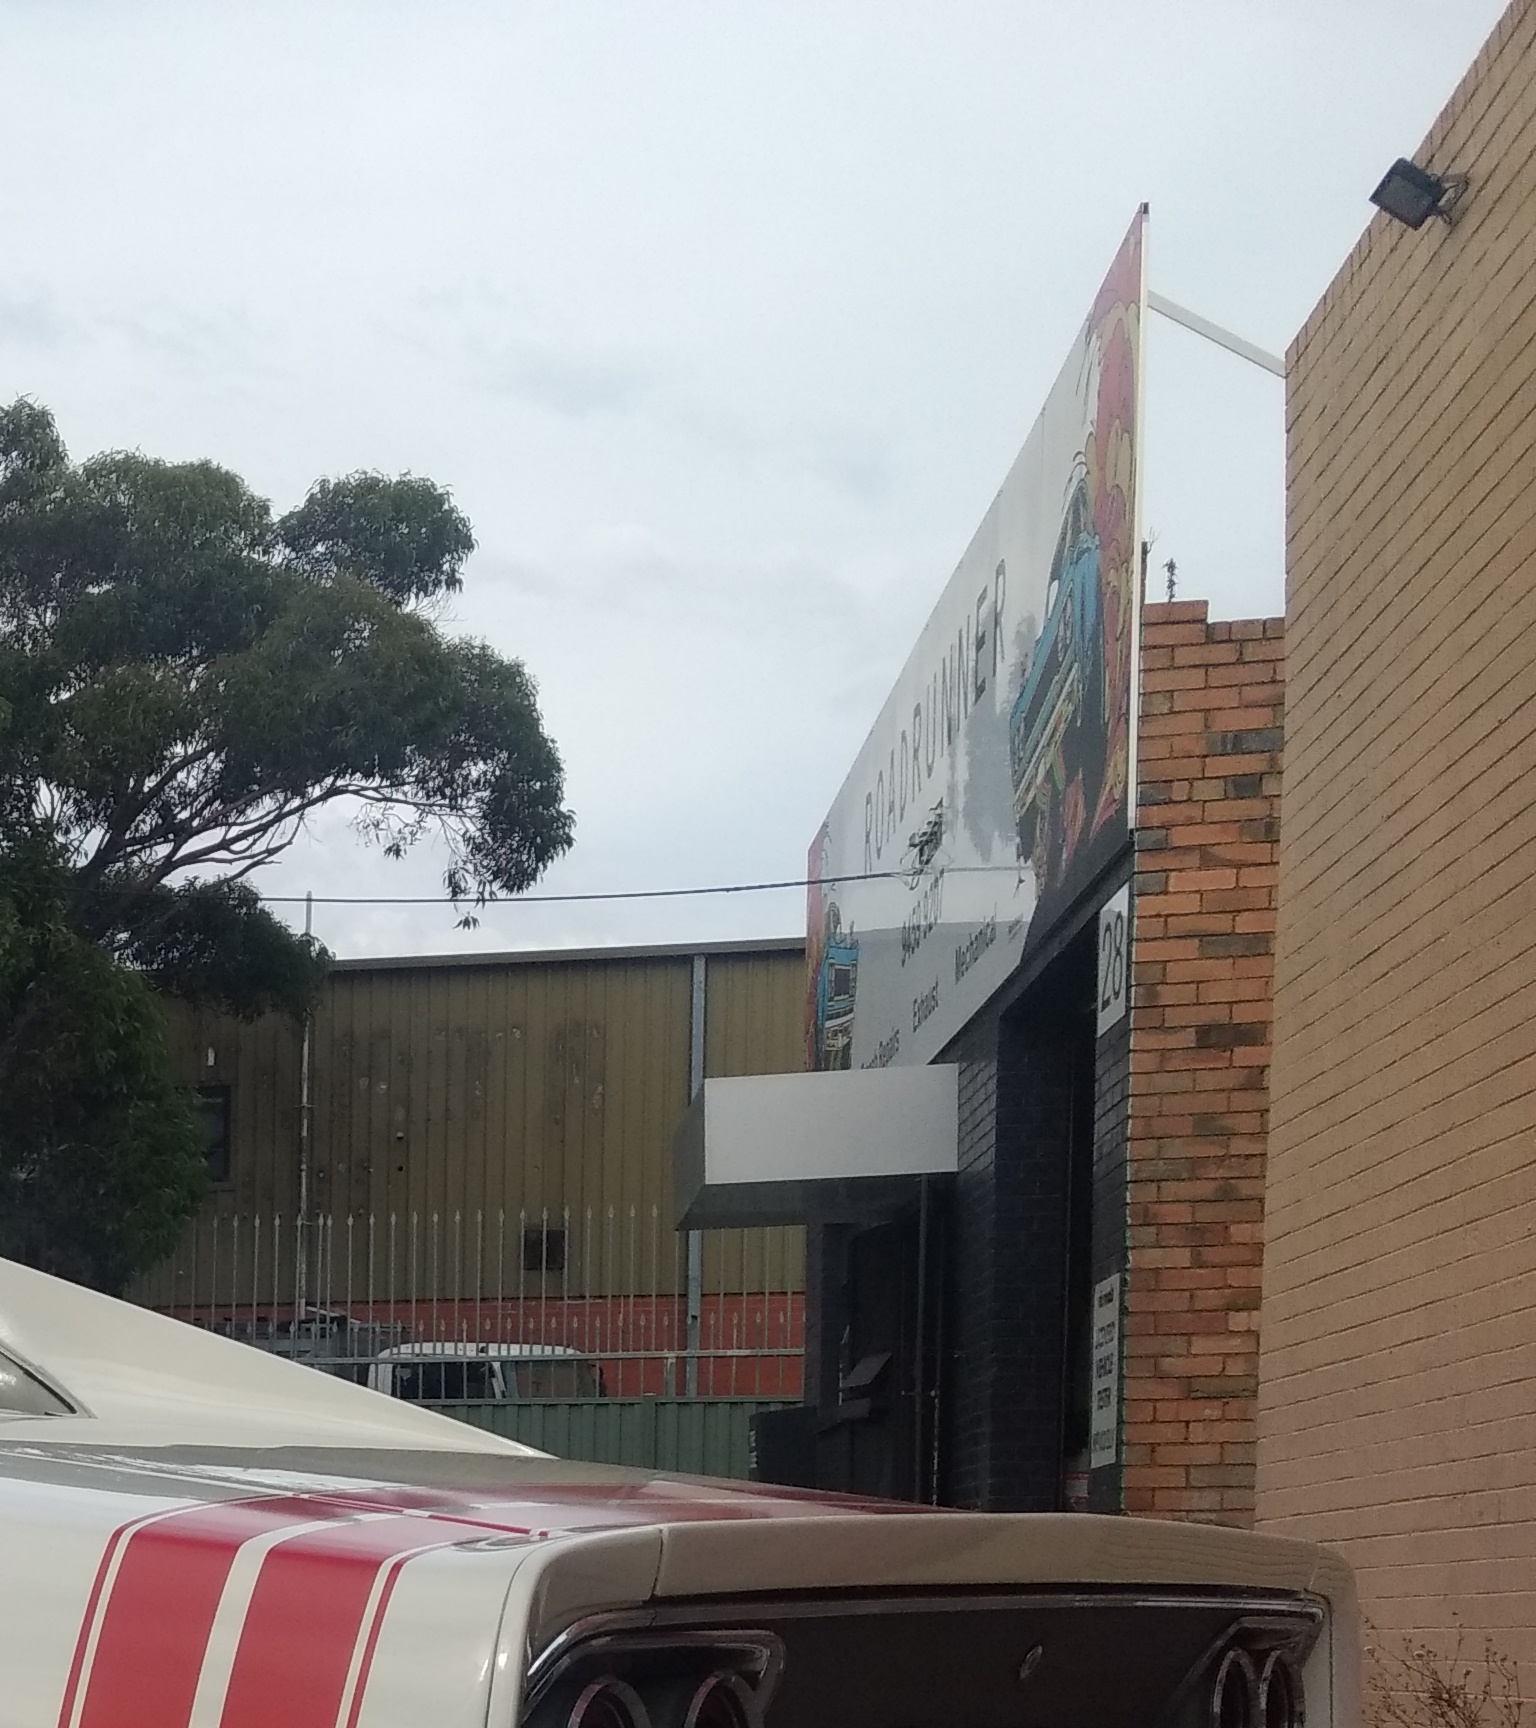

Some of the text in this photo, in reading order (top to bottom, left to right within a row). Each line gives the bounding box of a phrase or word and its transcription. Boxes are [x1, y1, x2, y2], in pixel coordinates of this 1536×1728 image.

[864, 557, 1006, 874] ROADRUNNER
[913, 974, 939, 1033] Exhaust
[954, 901, 997, 985] Mechanical
[1101, 910, 1123, 1013] 28
